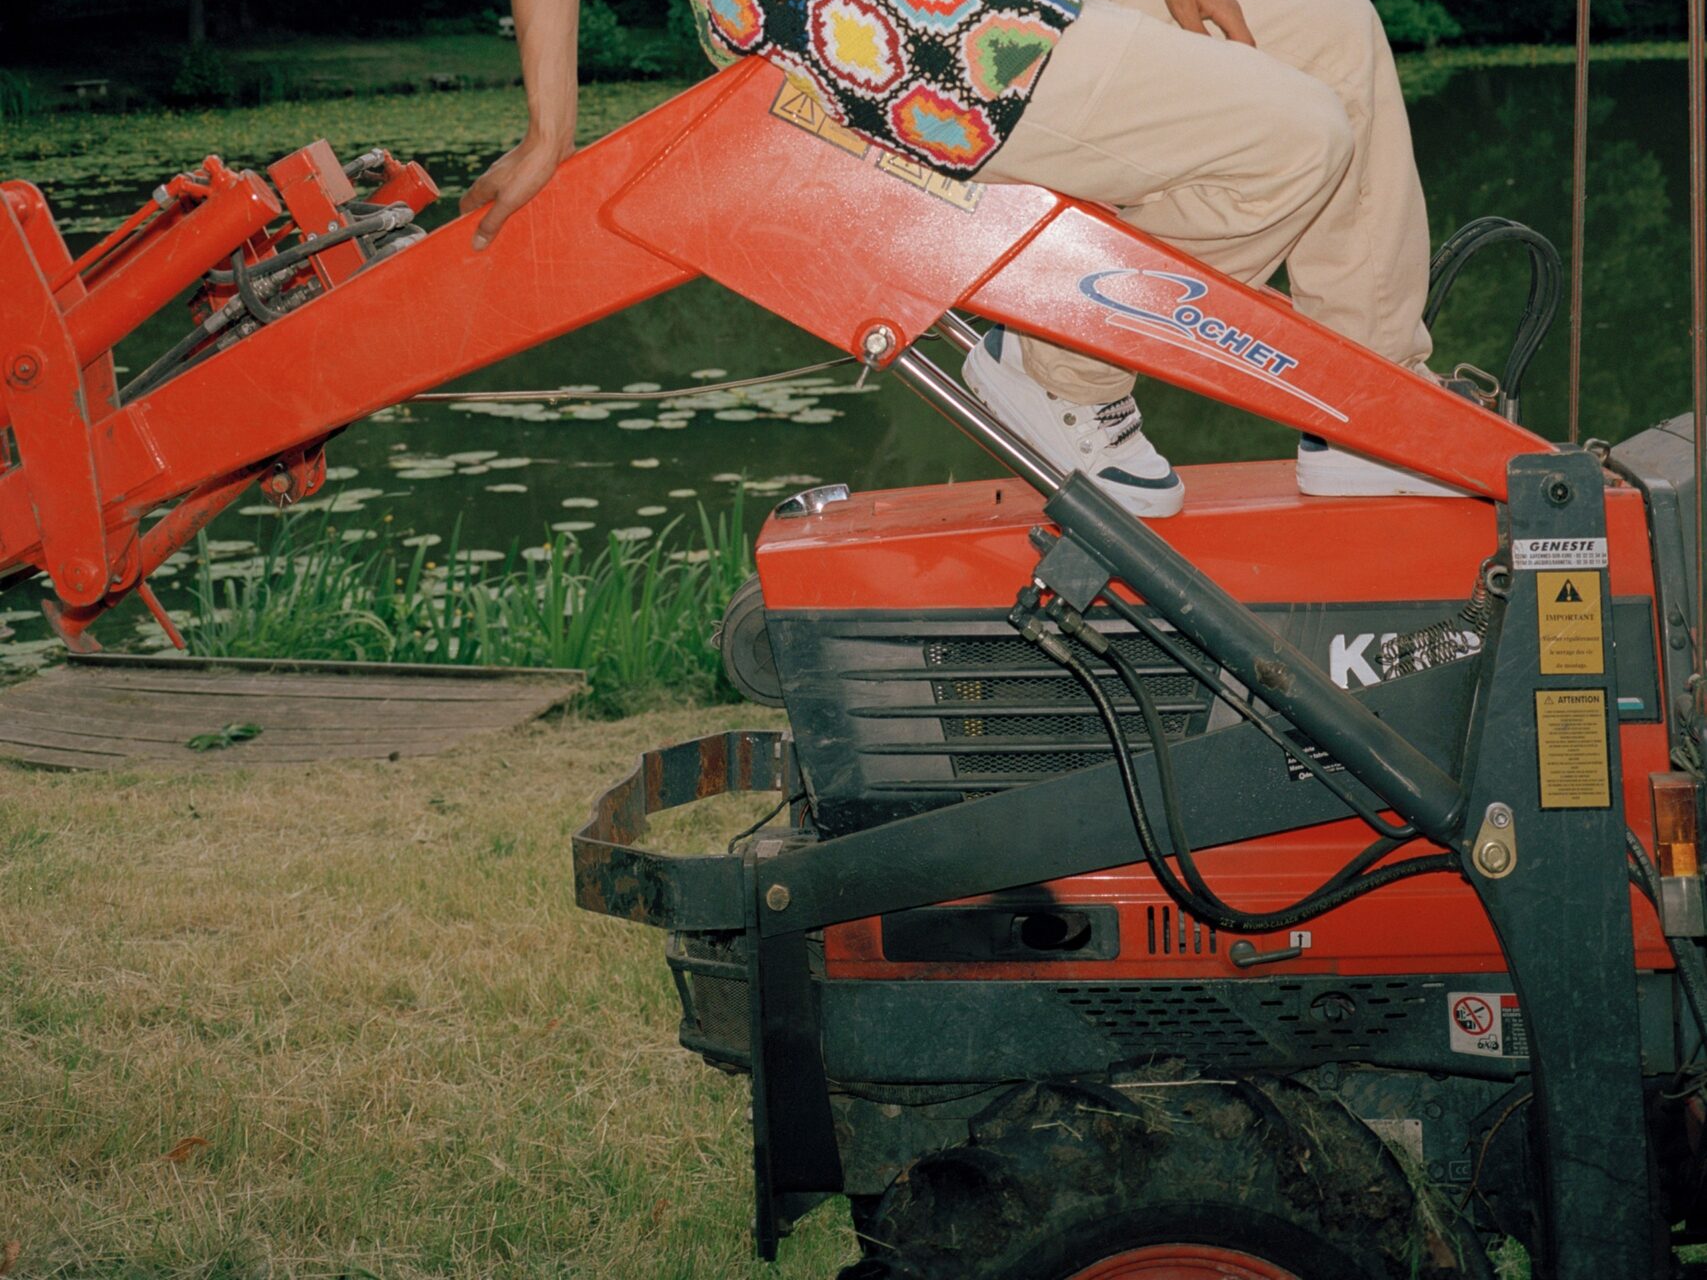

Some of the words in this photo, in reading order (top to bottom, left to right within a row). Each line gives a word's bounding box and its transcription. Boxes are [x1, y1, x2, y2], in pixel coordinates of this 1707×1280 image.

[1078, 269, 1298, 376] COCHET
[1529, 540, 1595, 552] GENESTE
[1546, 613, 1594, 621] IMPORTANT
[1558, 695, 1600, 705] ATTENTION
